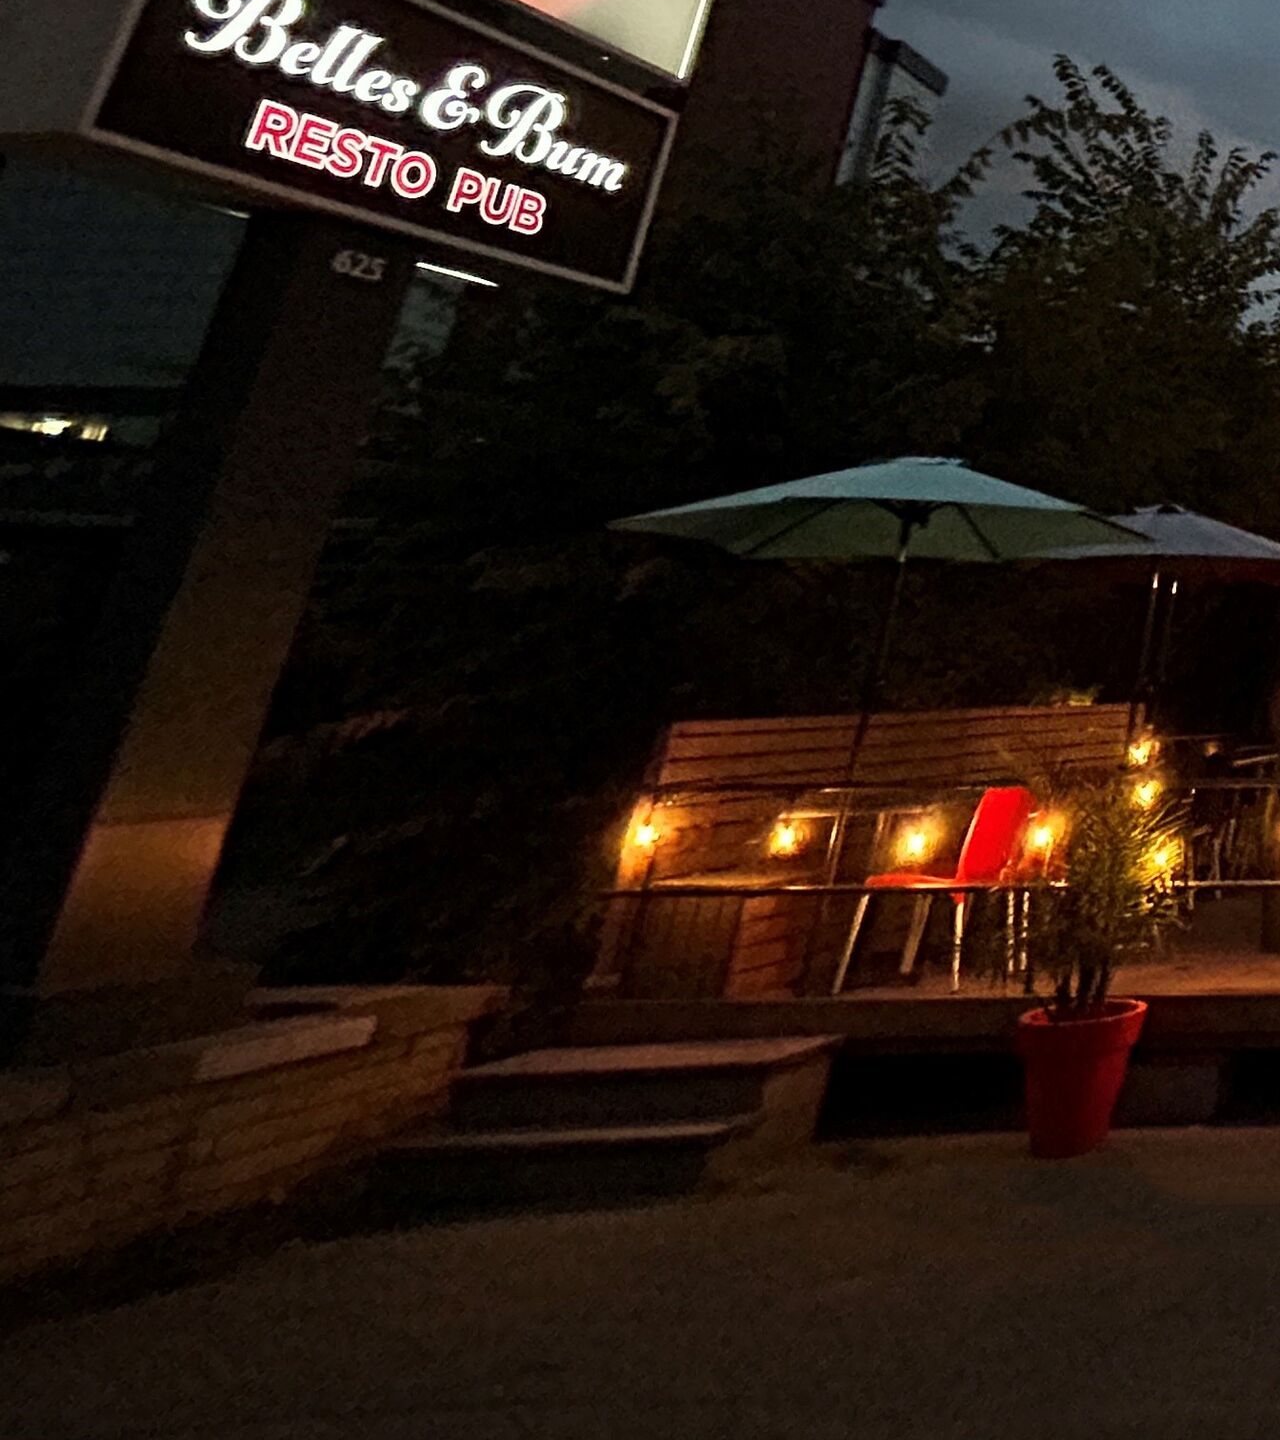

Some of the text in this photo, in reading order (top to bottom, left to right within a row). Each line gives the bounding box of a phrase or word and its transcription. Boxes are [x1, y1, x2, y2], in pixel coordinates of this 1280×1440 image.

[245, 99, 547, 236] RESTO PUB
[421, 64, 489, 130] &
[480, 83, 627, 192] Bum
[328, 249, 387, 282] 625
